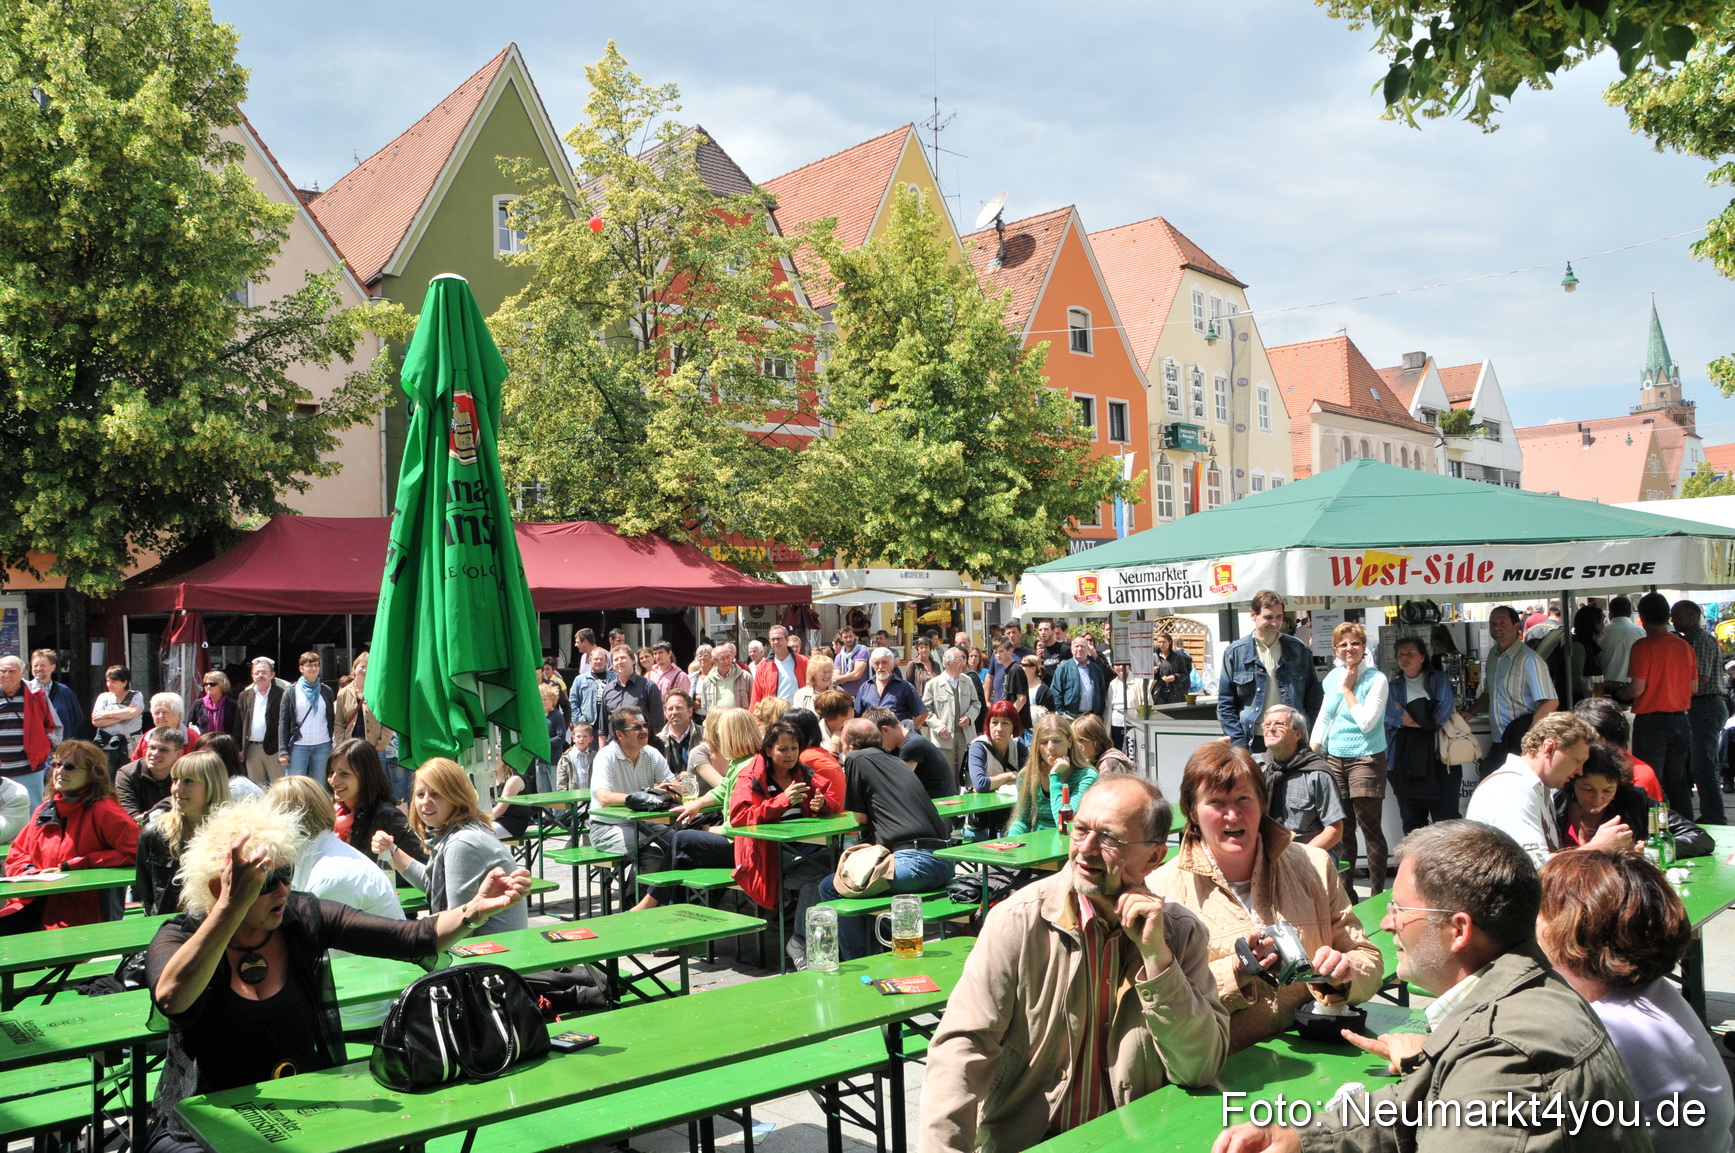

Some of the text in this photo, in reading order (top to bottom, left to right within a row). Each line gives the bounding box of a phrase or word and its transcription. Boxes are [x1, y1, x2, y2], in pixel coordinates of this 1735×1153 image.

[1118, 567, 1189, 586] Neumarkter
[1328, 553, 1494, 587] West-Side
[1502, 561, 1656, 582] MUSIC STORE
[1107, 581, 1203, 605] Lammsbräu
